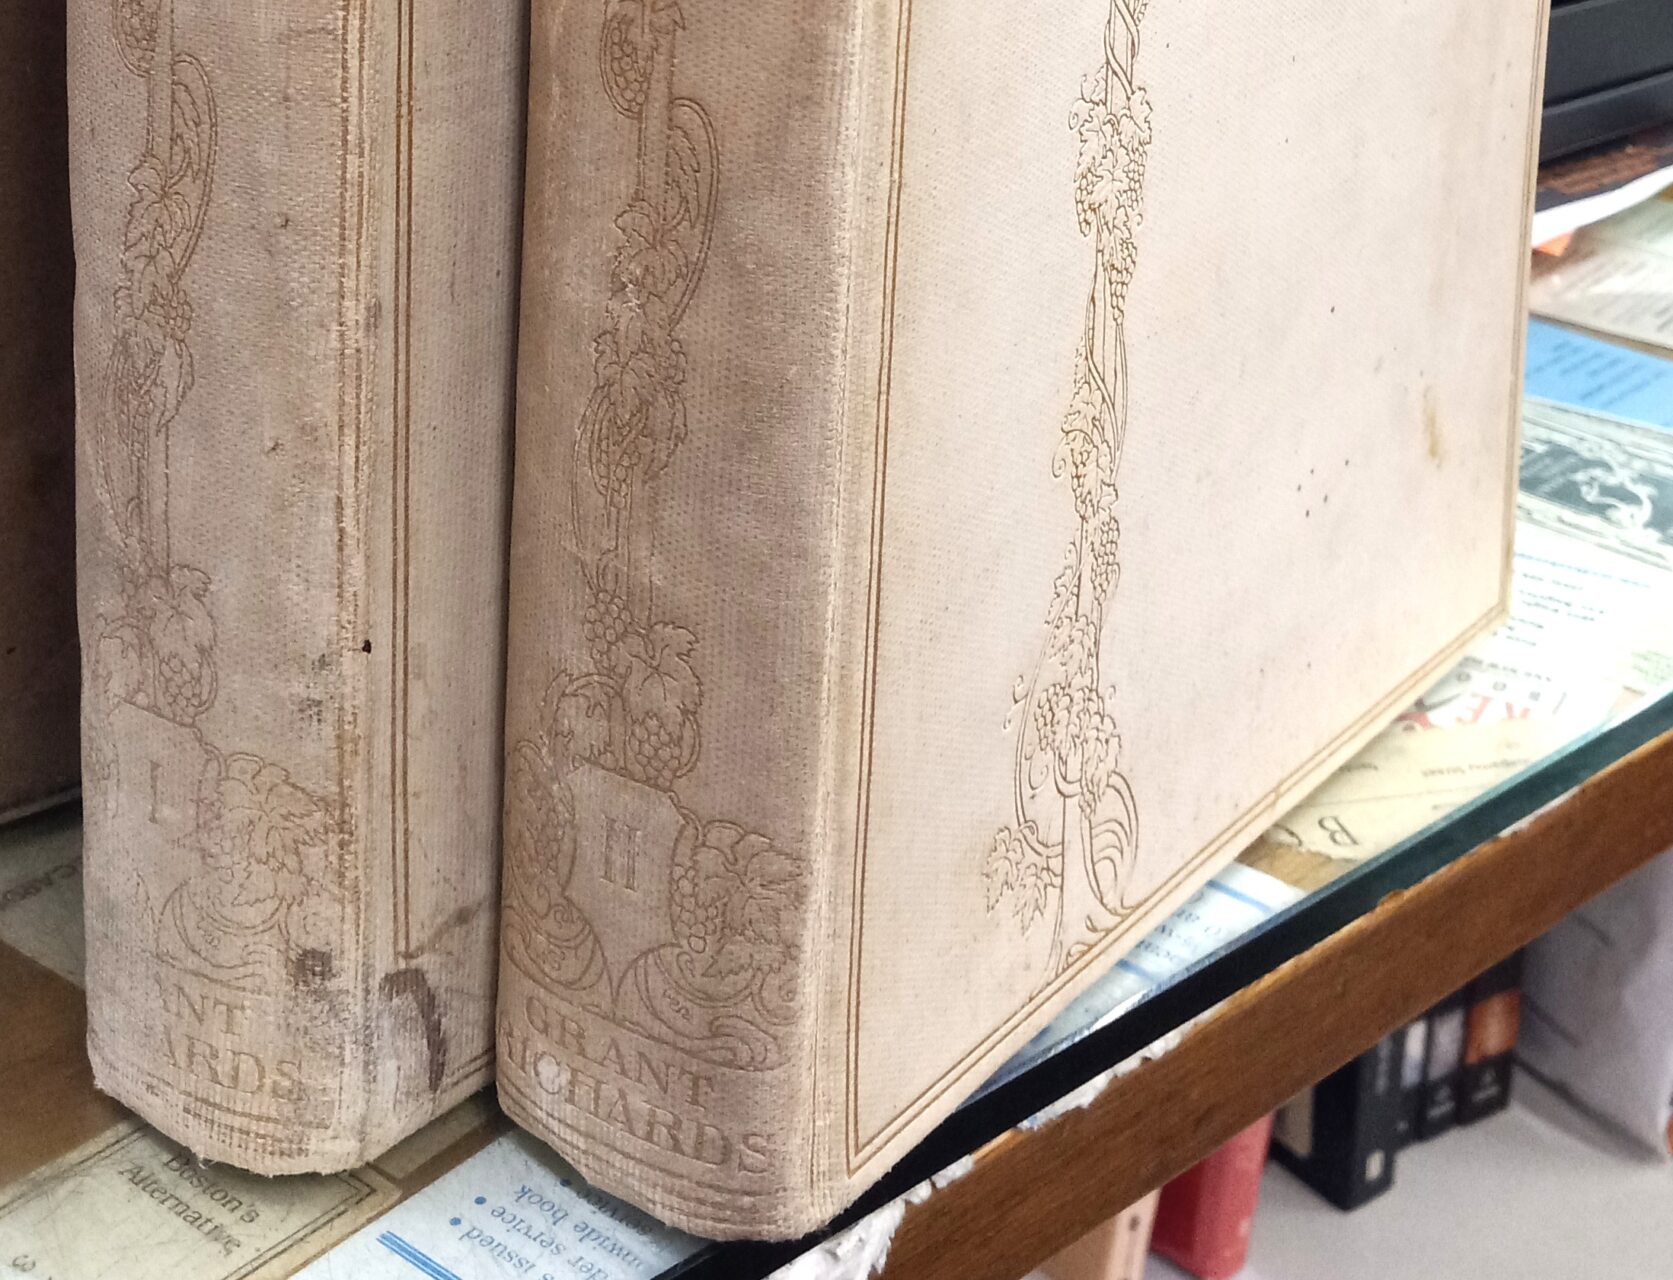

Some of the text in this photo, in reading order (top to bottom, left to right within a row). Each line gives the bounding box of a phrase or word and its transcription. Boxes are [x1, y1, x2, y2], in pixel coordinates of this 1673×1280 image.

[525, 996, 715, 1111] GRANT
[163, 1153, 261, 1224] Boston's
[514, 1183, 569, 1227] book
[459, 1225, 536, 1274] issued
[490, 1205, 567, 1256] service
